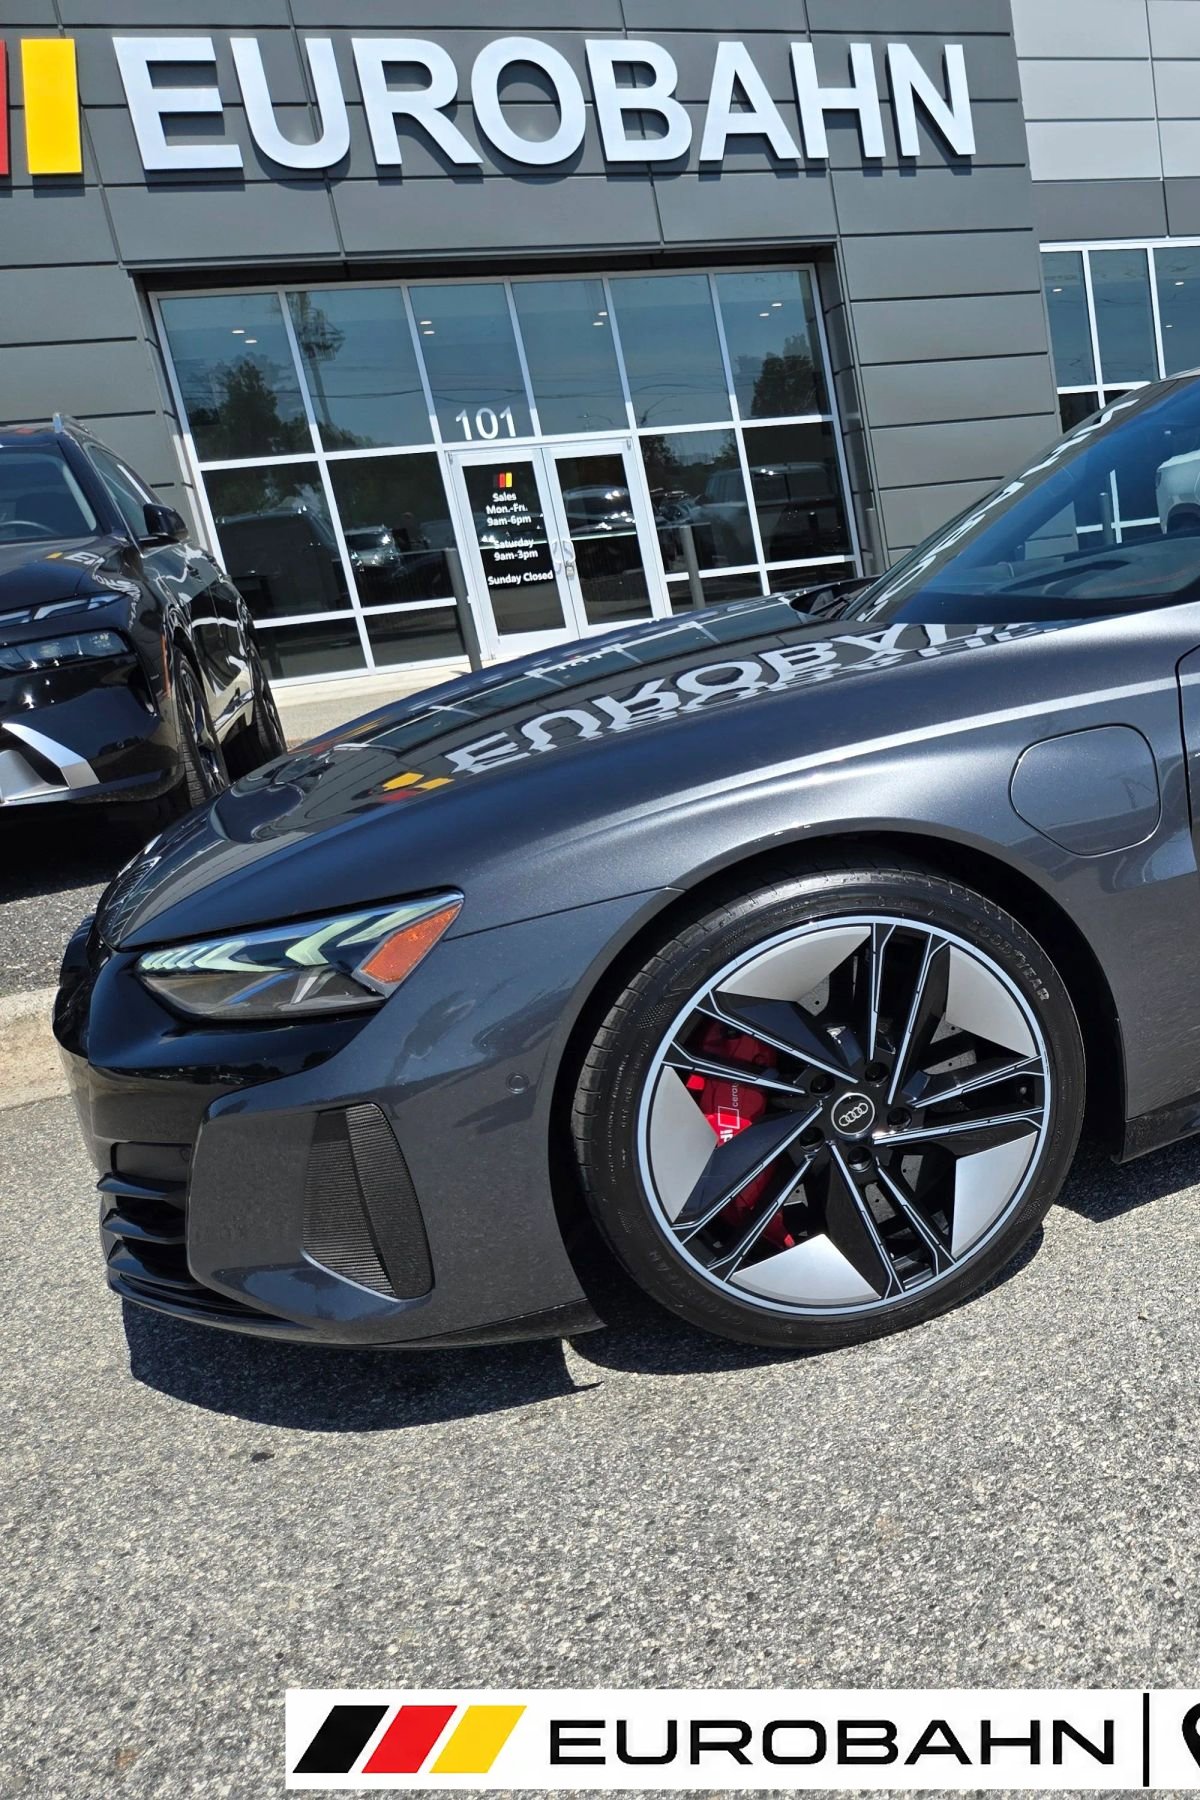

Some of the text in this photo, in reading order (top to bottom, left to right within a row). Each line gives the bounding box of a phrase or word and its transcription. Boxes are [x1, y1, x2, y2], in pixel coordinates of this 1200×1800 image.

[112, 36, 976, 171] EUROBAHN
[455, 406, 517, 440] 101
[492, 492, 517, 502] Sales
[487, 515, 532, 526] 9am-6pm
[494, 538, 534, 549] Saturday
[494, 550, 538, 561] 9am-3pm
[488, 570, 554, 586] Sunday Closed
